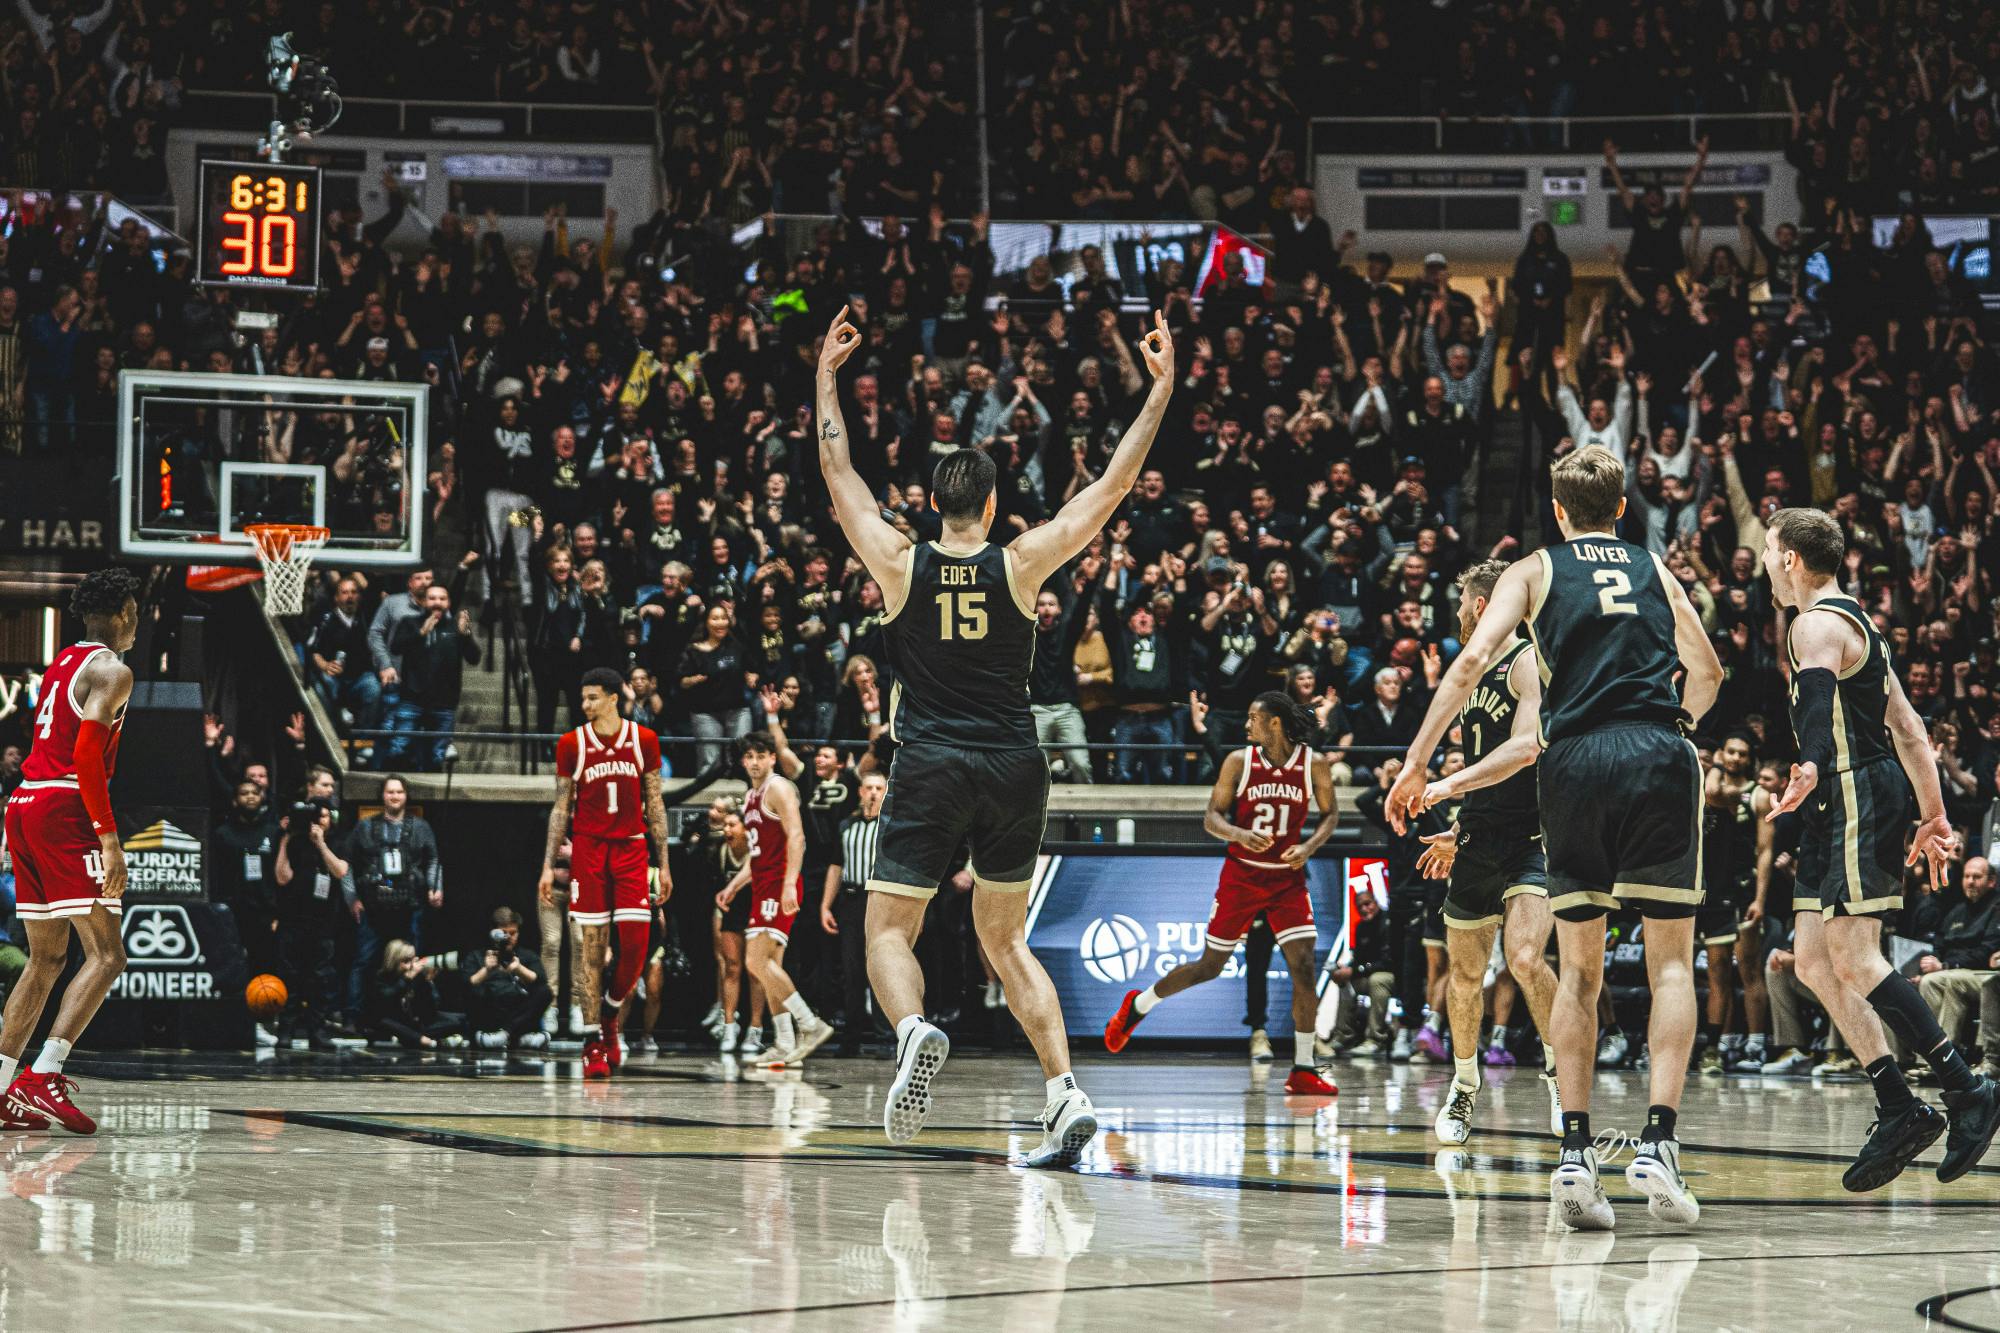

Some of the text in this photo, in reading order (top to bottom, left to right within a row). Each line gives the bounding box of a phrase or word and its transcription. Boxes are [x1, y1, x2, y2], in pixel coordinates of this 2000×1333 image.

[231, 174, 308, 213] 6:31
[221, 212, 296, 276] 30
[228, 275, 288, 285] DAKTRONICS
[1572, 543, 1632, 563] LOYER
[940, 565, 978, 585] EDEY
[1592, 569, 1638, 615] 2
[935, 592, 988, 640] 15
[36, 680, 60, 740] 4
[1460, 686, 1511, 725] URDUE
[1471, 723, 1482, 756] 1
[584, 760, 639, 784] INDIANA
[606, 782, 618, 814] 1
[1247, 783, 1303, 803] INDIANA
[1252, 802, 1290, 837] 21
[125, 851, 201, 869] PURDUE
[126, 868, 201, 882] FEDERAL
[166, 882, 201, 892] UNION
